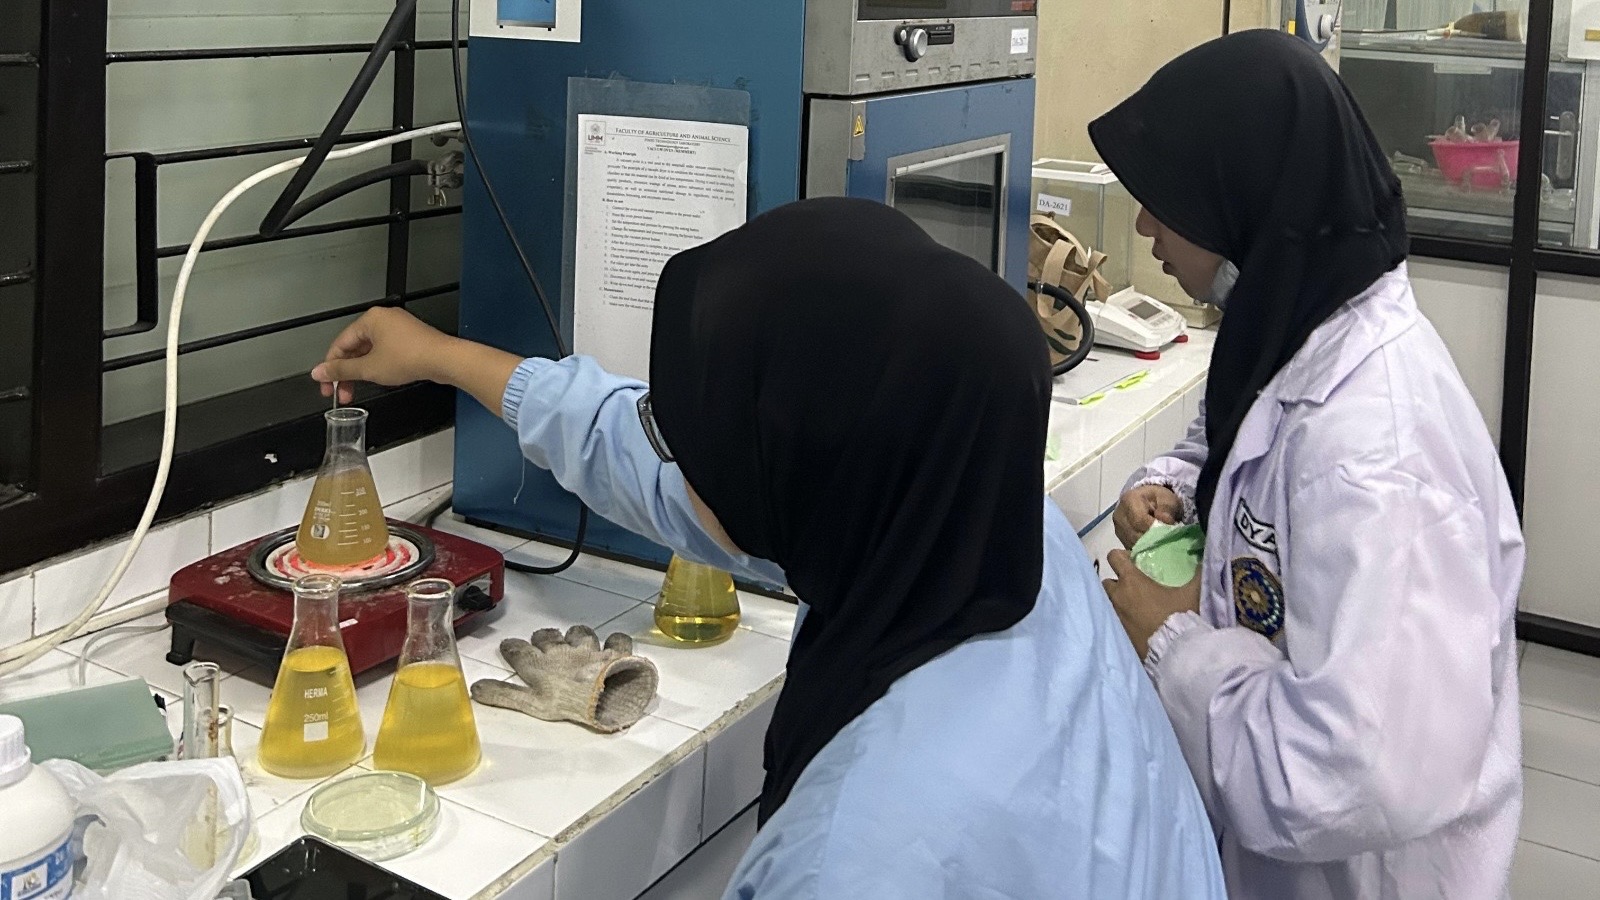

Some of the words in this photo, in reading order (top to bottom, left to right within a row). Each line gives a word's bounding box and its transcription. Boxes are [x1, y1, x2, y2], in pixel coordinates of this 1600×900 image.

[645, 130, 679, 138] AGRICULTURE
[711, 135, 731, 143] SCIENCE
[1038, 199, 1069, 211] DA-2621
[304, 686, 328, 699] HERMA
